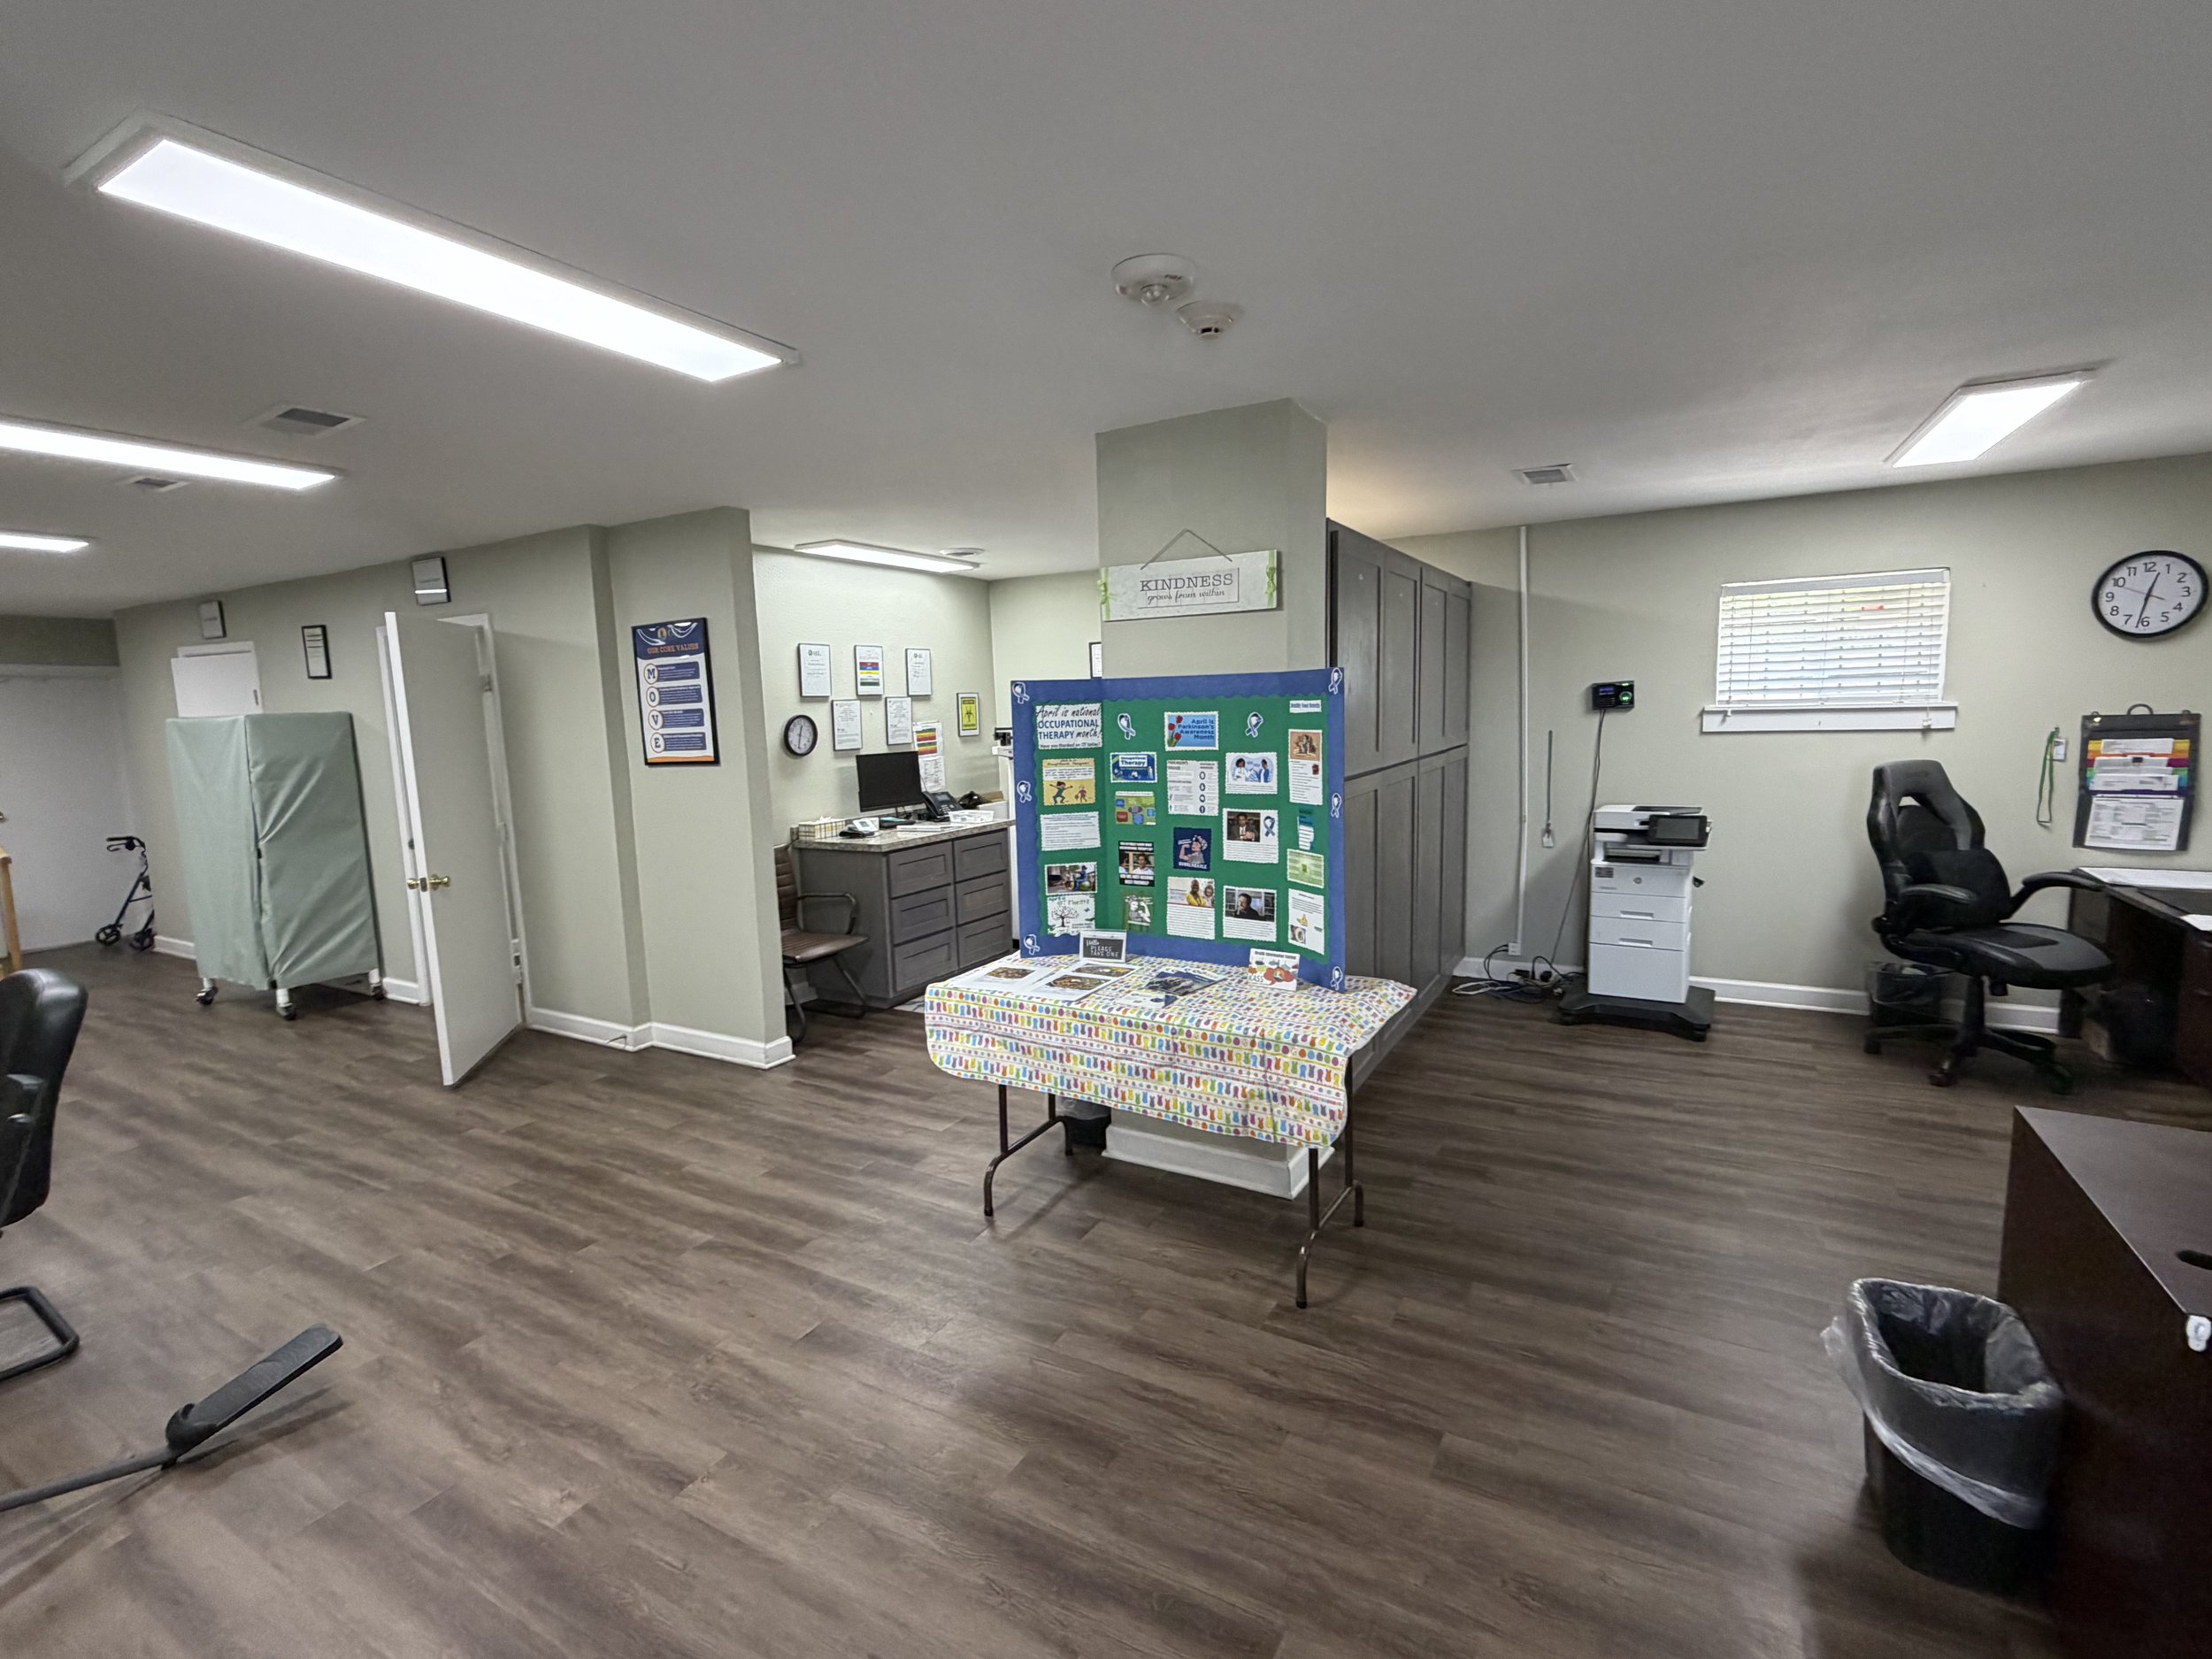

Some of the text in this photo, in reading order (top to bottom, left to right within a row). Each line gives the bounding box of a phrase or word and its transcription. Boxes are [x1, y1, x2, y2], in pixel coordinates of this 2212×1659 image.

[2127, 567, 2137, 577] 11
[2143, 562, 2157, 572] 12
[2166, 565, 2170, 574] 1
[1140, 573, 1233, 591] KINDNESS
[2111, 577, 2126, 588] 10
[2177, 572, 2187, 583] 2
[1147, 587, 1225, 605] grows from within
[2106, 592, 2115, 603] 9
[2181, 587, 2191, 597] 3
[2110, 606, 2120, 616] 8
[2173, 603, 2183, 612] 4
[2124, 615, 2133, 626] 7
[2140, 617, 2150, 627] 6
[2161, 612, 2170, 623] 5
[647, 668, 656, 680] M
[649, 691, 657, 703] O
[1036, 704, 1101, 720] April is national
[651, 714, 659, 726] V
[1038, 718, 1099, 729] OCCUPATIONAL
[1038, 730, 1074, 741] THERAPY
[654, 737, 661, 749] E
